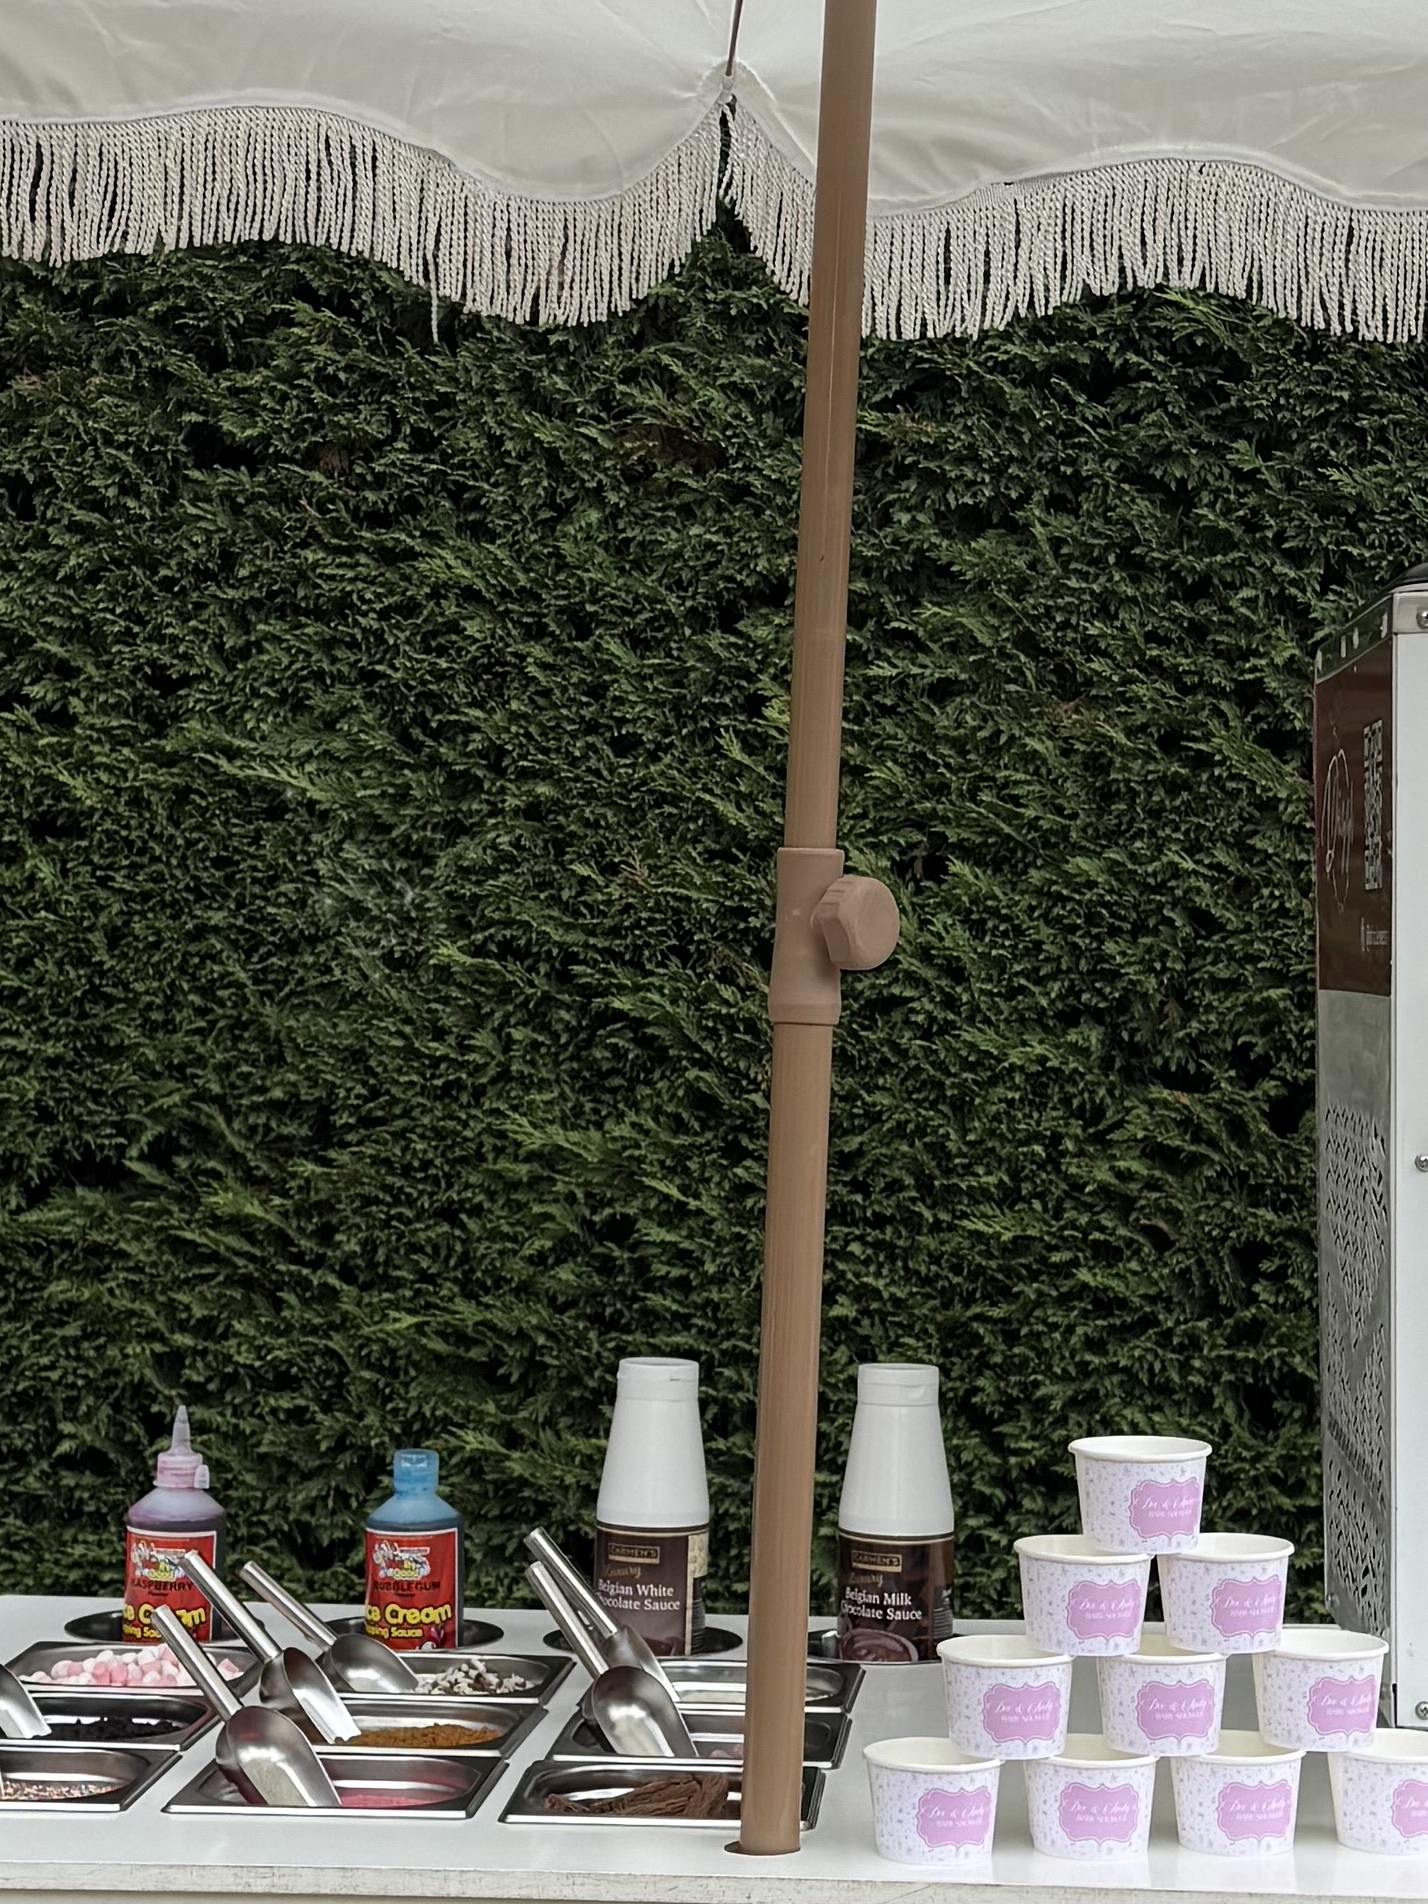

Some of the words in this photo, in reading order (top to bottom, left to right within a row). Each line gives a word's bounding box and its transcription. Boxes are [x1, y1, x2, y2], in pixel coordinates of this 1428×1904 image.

[598, 1578, 633, 1596] Belgian
[636, 1583, 674, 1596] White
[845, 1586, 880, 1604] Belgian
[883, 1592, 912, 1605] Milk
[644, 1598, 681, 1610] Sauce
[385, 1603, 452, 1625] Cream
[886, 1607, 922, 1620] Sauce
